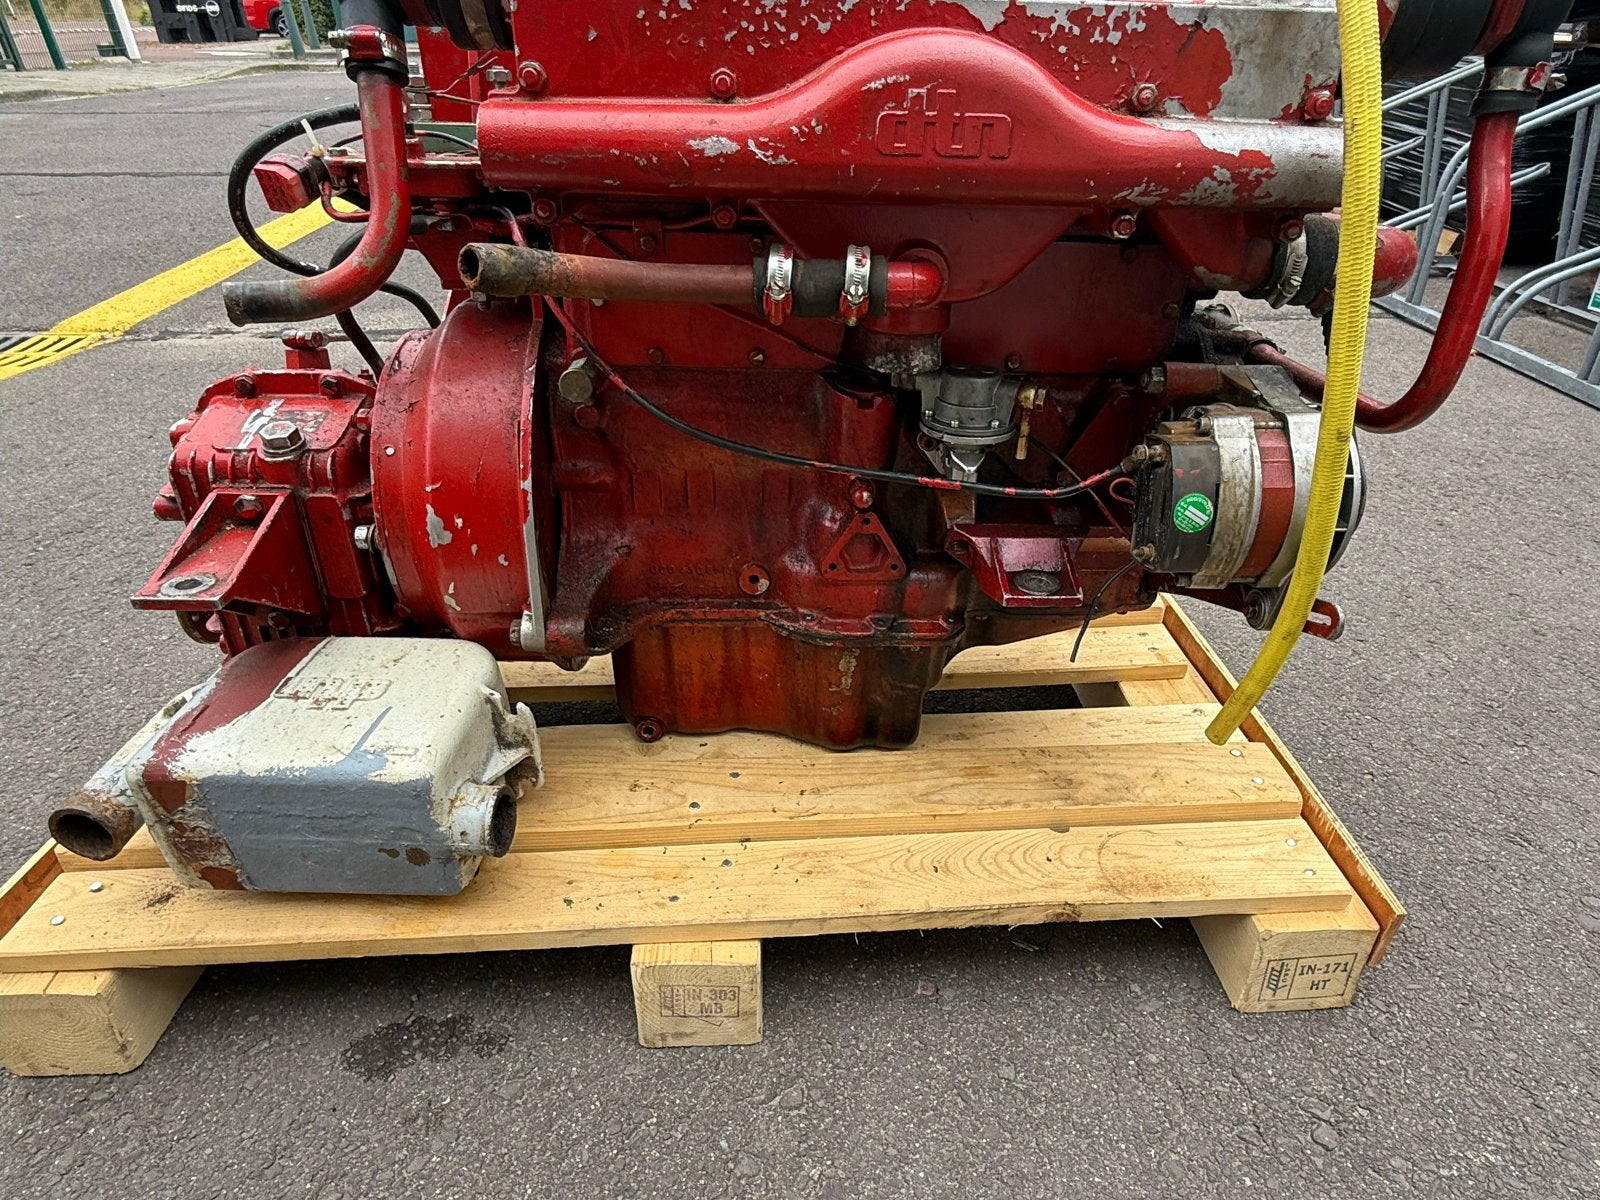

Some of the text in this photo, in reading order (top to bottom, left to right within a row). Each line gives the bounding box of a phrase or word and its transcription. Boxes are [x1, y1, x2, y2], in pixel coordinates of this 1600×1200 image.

[1298, 961, 1349, 976] IN-171
[1309, 978, 1331, 991] HT
[686, 988, 737, 1001] IN-303
[700, 1002, 724, 1014] MB
